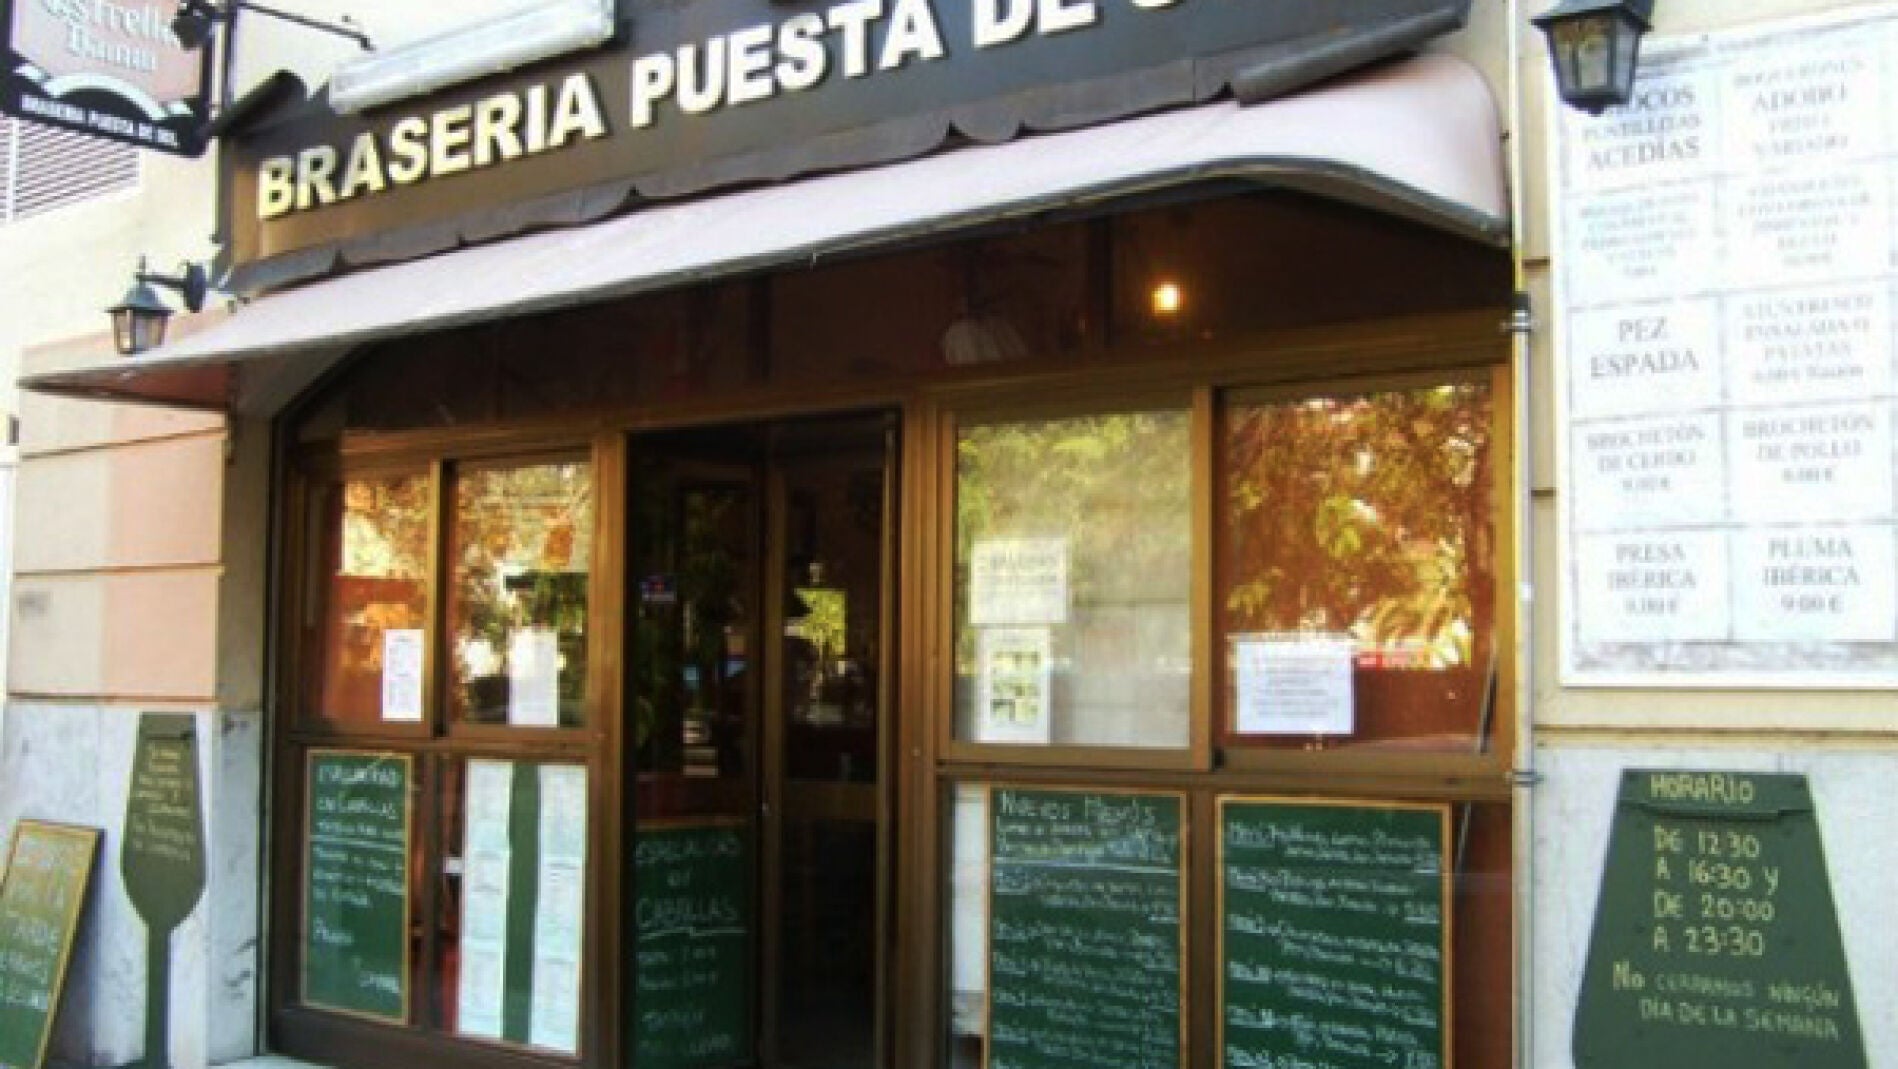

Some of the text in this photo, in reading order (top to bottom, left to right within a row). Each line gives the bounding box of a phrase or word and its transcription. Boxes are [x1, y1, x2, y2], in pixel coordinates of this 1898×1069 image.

[258, 72, 605, 219] BRASERIA
[630, 0, 945, 128] PUESTA
[1618, 315, 1669, 343] PEZ
[1590, 349, 1700, 379] ESPADA
[1650, 772, 1756, 804] HORARIO
[1654, 824, 1683, 854] DE
[1656, 855, 1671, 882] A
[1688, 858, 1752, 891] 16:30
[1653, 889, 1776, 923] DE 20:00
[1653, 925, 1766, 957] A 23:30
[1678, 1002, 1706, 1026] DE
[1712, 1005, 1738, 1027] LA
[1743, 1007, 1841, 1041] SEMANA
